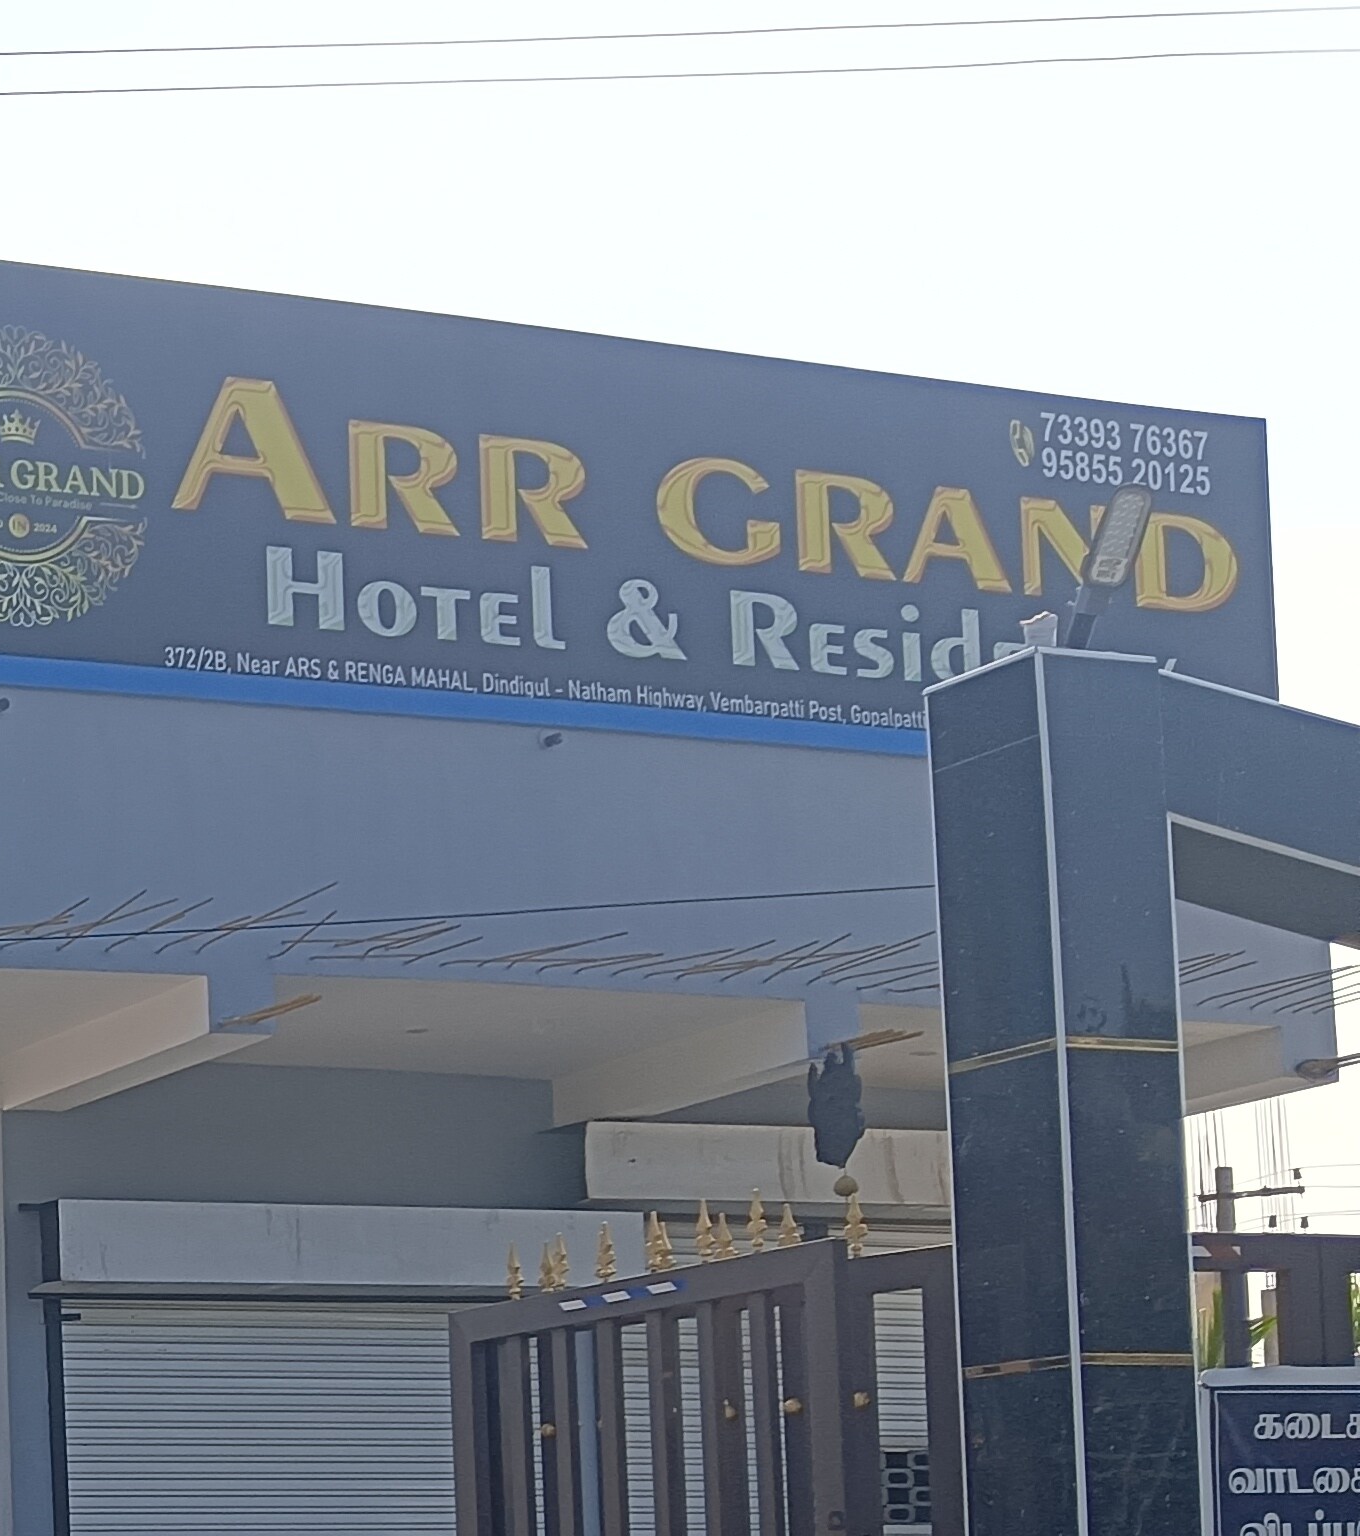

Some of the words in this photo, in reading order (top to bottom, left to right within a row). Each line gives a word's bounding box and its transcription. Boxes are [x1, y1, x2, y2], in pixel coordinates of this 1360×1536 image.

[1040, 412, 1122, 452] 73393
[1129, 422, 1209, 461] 76367
[10, 460, 145, 500] GRAND
[170, 375, 588, 550] ARR
[656, 457, 1239, 613] GRAND
[1041, 447, 1123, 486] 95855
[1130, 458, 1211, 496] 20125
[30, 494, 43, 506] To
[44, 495, 93, 511] Paradise
[33, 523, 58, 533] 2024
[607, 578, 687, 661] &
[164, 646, 231, 674] 372/2B,
[237, 653, 279, 676] Near
[284, 657, 322, 679] ARS
[327, 660, 340, 681] &
[345, 660, 406, 686] RENGA
[411, 666, 478, 694] MAHAL,
[568, 679, 631, 704] Natham
[637, 685, 707, 713] Highway,
[710, 691, 804, 719] Vembarpatti
[809, 702, 847, 725] Post,
